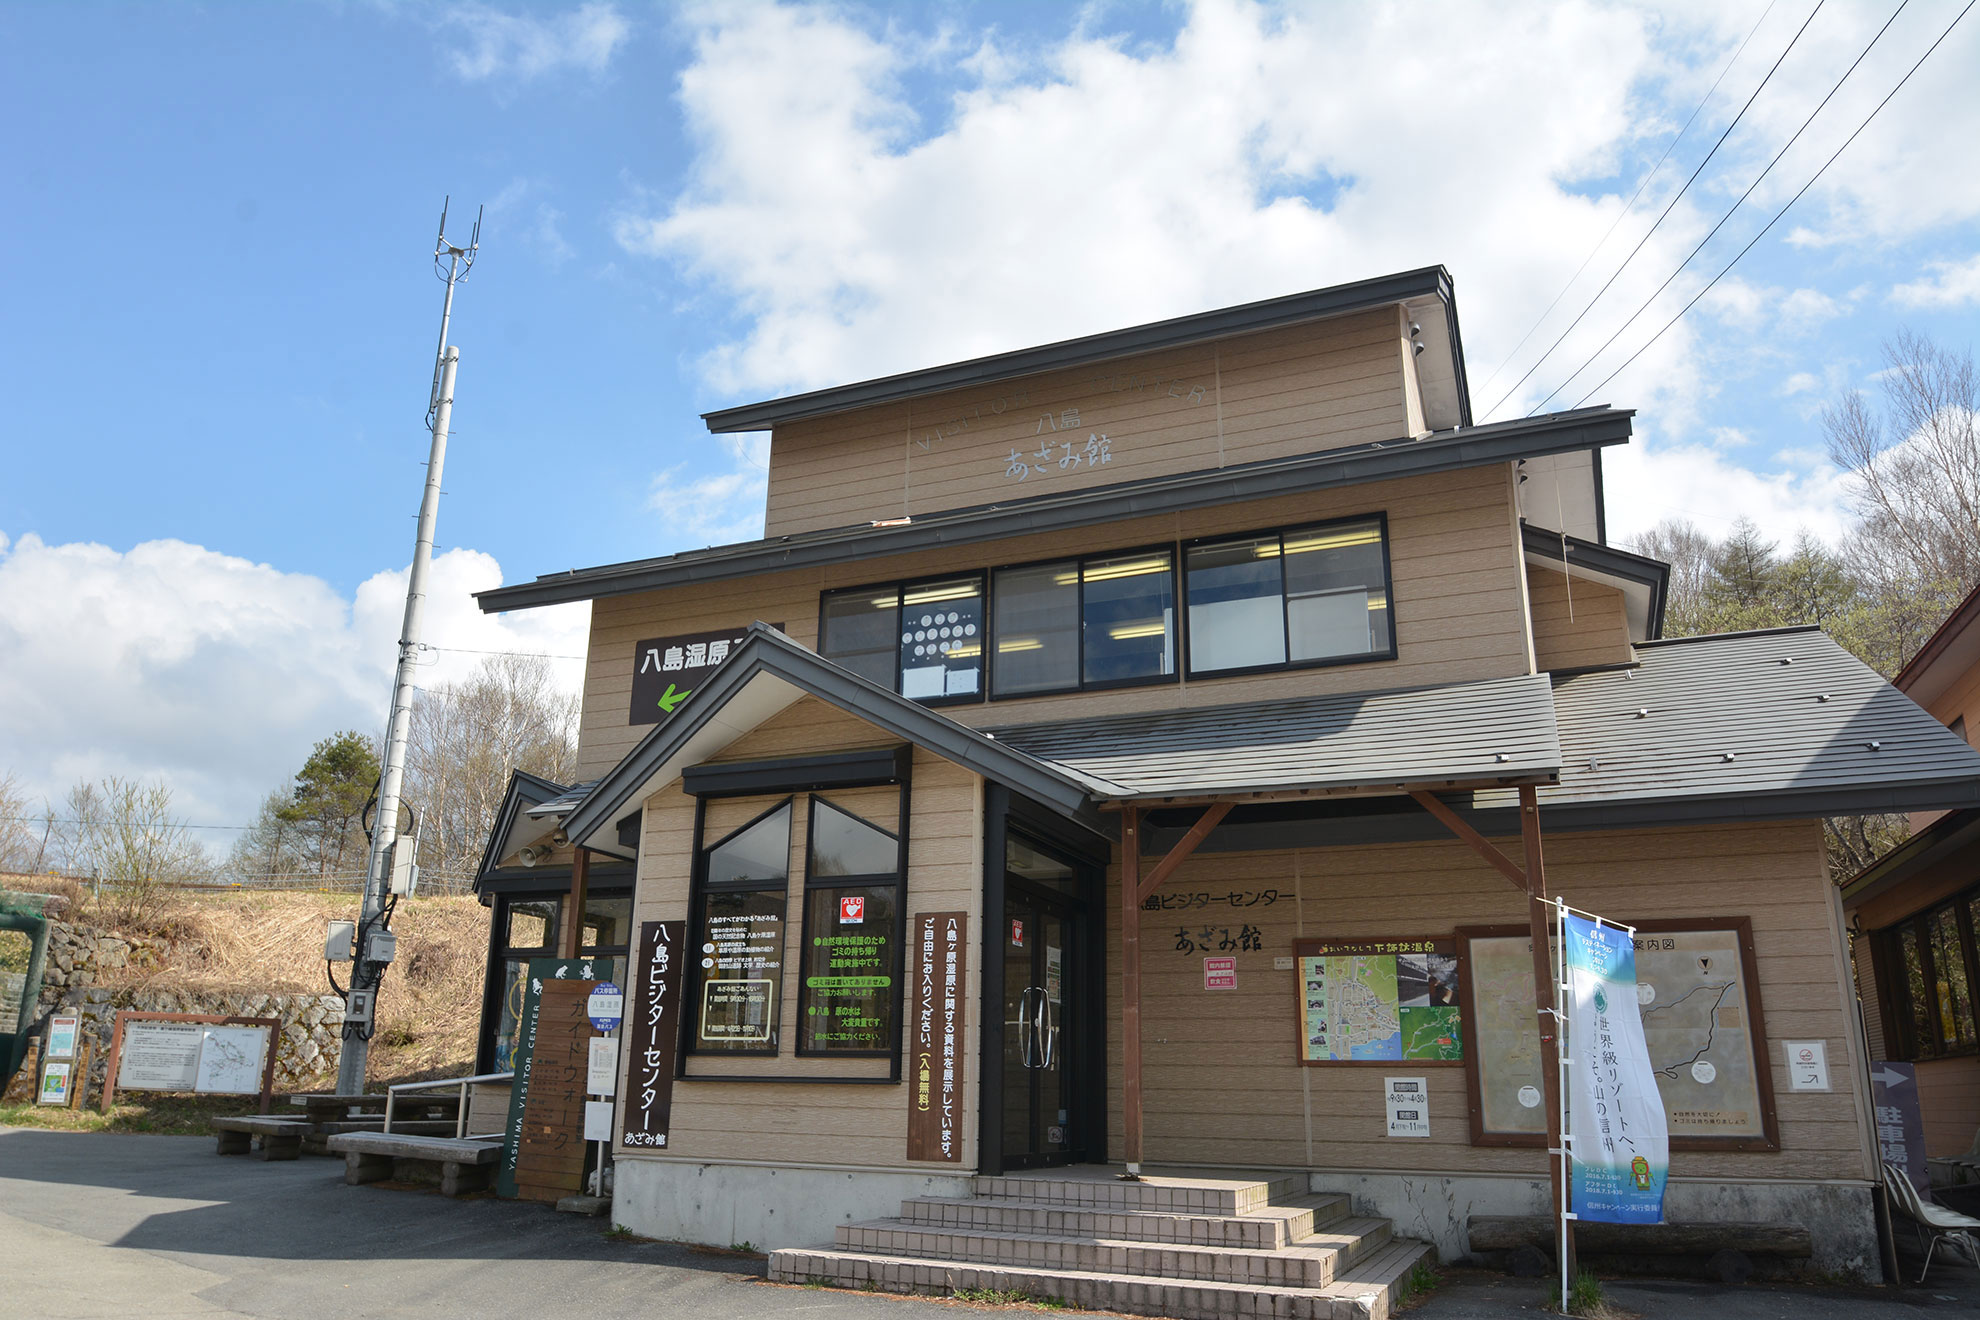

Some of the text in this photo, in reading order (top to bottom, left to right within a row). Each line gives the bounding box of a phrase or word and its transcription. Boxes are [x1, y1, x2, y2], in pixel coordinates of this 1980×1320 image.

[916, 373, 1207, 452] VISITOR CENTER
[1036, 407, 1082, 434] 八島
[1003, 433, 1112, 482] あざみ館
[1141, 889, 1296, 911] 島ビジターセンター
[822, 936, 886, 946] 自然環境保護のため
[832, 947, 877, 956] ゴミの持ち帰り
[1175, 924, 1262, 956] あざみ館
[640, 923, 671, 1130] 八島ビジターセンター
[508, 1004, 541, 1171] YASHIMA VISITOR CENTER
[624, 1132, 666, 1145] あざみ館
